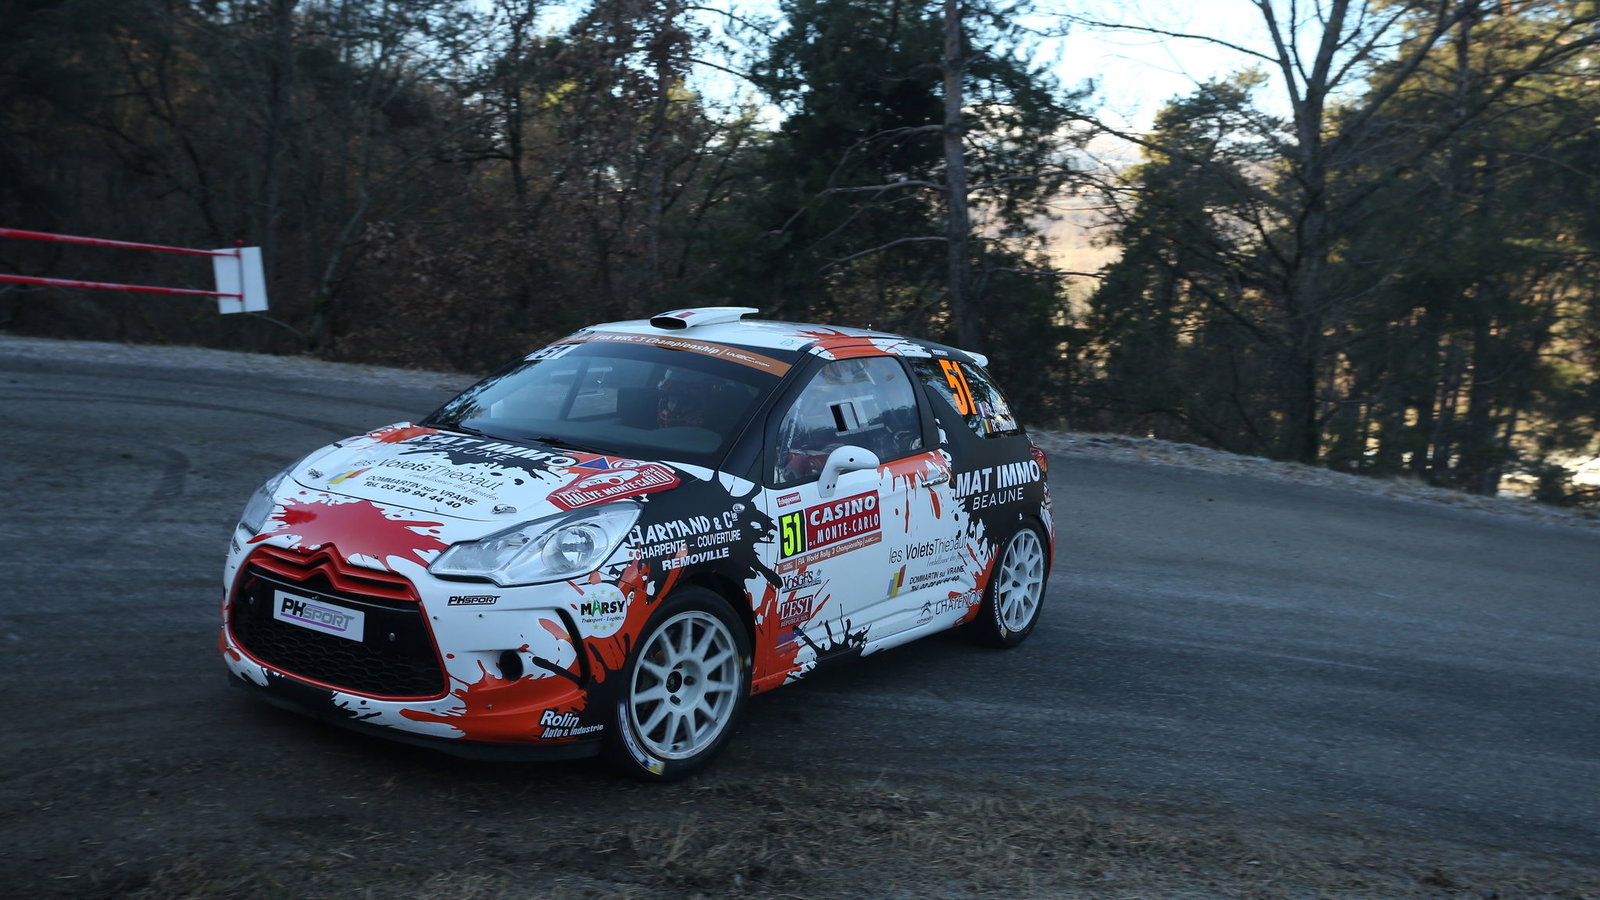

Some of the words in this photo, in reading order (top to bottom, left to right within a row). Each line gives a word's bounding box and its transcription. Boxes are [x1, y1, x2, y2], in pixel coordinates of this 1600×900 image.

[613, 335, 634, 343] WRC
[646, 337, 720, 355] Championship
[939, 359, 978, 415] 51
[476, 442, 579, 467] IMMO
[639, 467, 657, 477] 2014
[956, 468, 992, 498] MAT
[996, 460, 1040, 489] IMMO
[366, 475, 422, 489] DOMMARTIN
[421, 485, 438, 493] sur
[439, 489, 478, 506] VRAINE
[411, 490, 427, 498] 94
[446, 500, 462, 508] 40
[565, 490, 602, 506] RALLYE
[602, 470, 672, 497] MONTE-CARLO
[972, 487, 1024, 510] BEAUNE
[810, 495, 876, 526] CASINO
[628, 516, 711, 547] HARMAND
[713, 517, 722, 530] &
[782, 512, 802, 557] 51
[817, 513, 879, 544] MONTE-CARLO
[634, 539, 687, 560] CHARPENTE
[697, 529, 741, 547] COUVERTURE
[806, 553, 820, 562] World
[820, 549, 831, 558] Rally
[836, 539, 863, 553] Championship
[888, 547, 903, 564] les
[661, 547, 730, 571] REMOVILLE
[909, 571, 939, 585] DOMMARTIN
[448, 595, 501, 606] PHSPORT
[580, 600, 626, 616] MARSY
[281, 597, 355, 629] PHSPORT
[540, 710, 579, 727] Rolin
[541, 727, 562, 738] Auto
